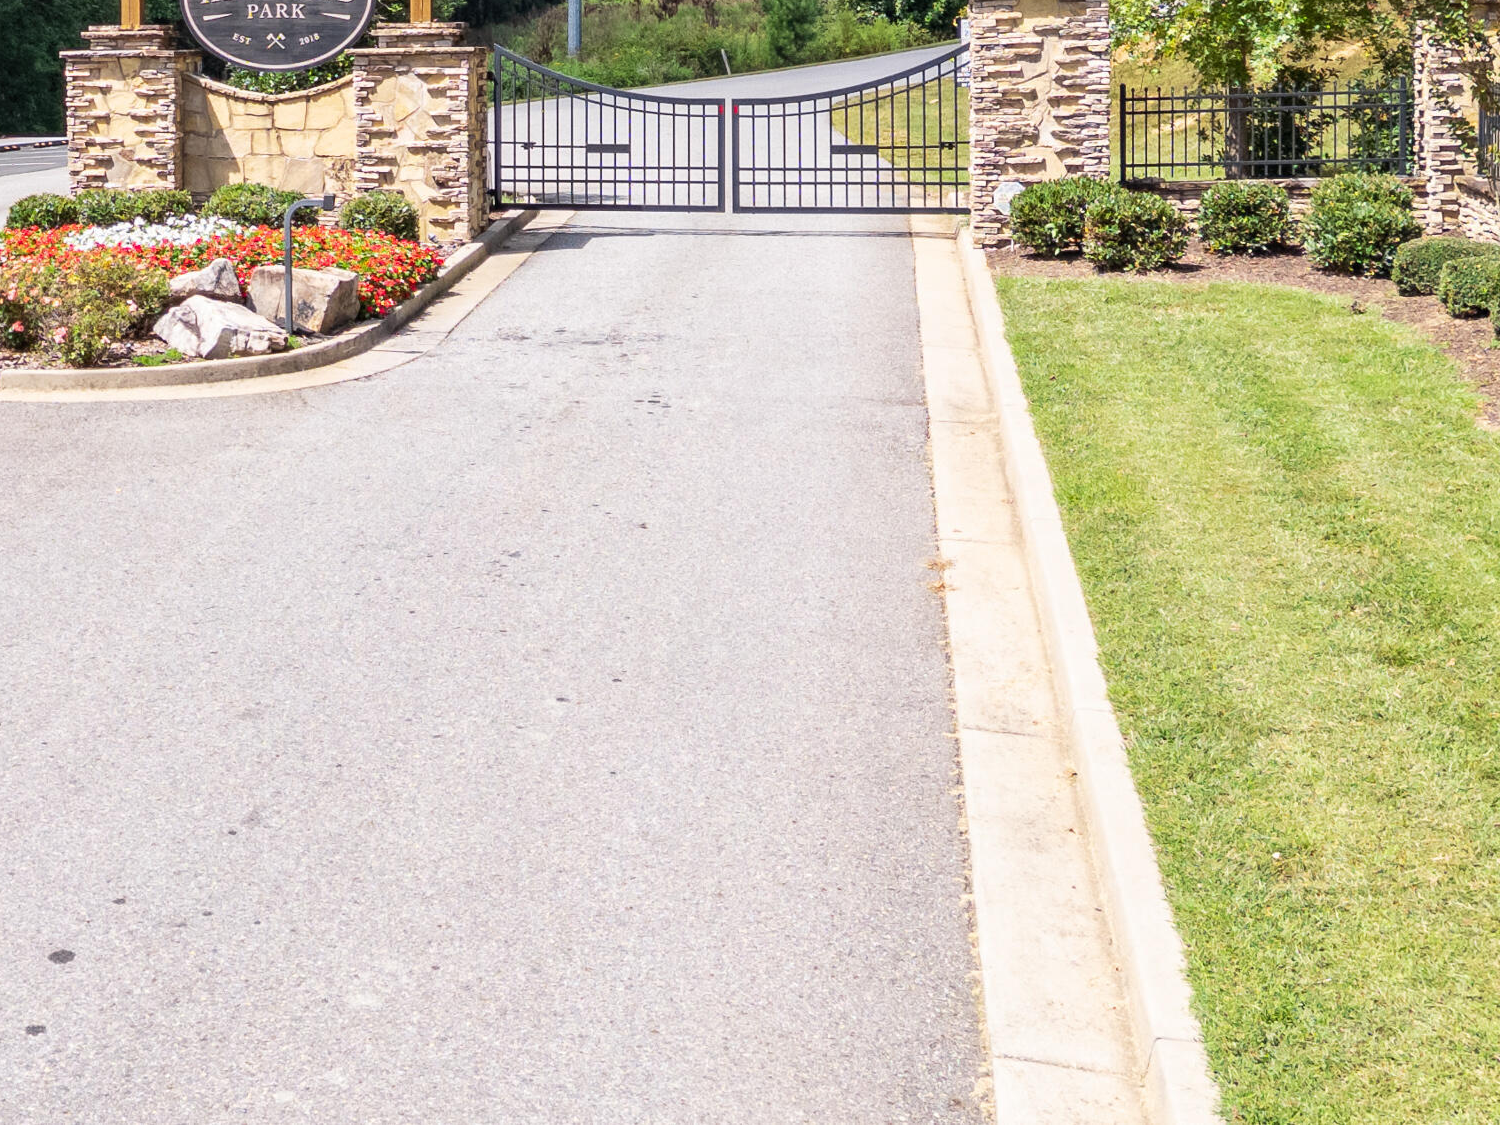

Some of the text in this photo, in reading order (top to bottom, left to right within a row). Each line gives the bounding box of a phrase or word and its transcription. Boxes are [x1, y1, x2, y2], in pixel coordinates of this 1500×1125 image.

[247, 3, 306, 19] PARK
[232, 32, 320, 46] EST 2018
